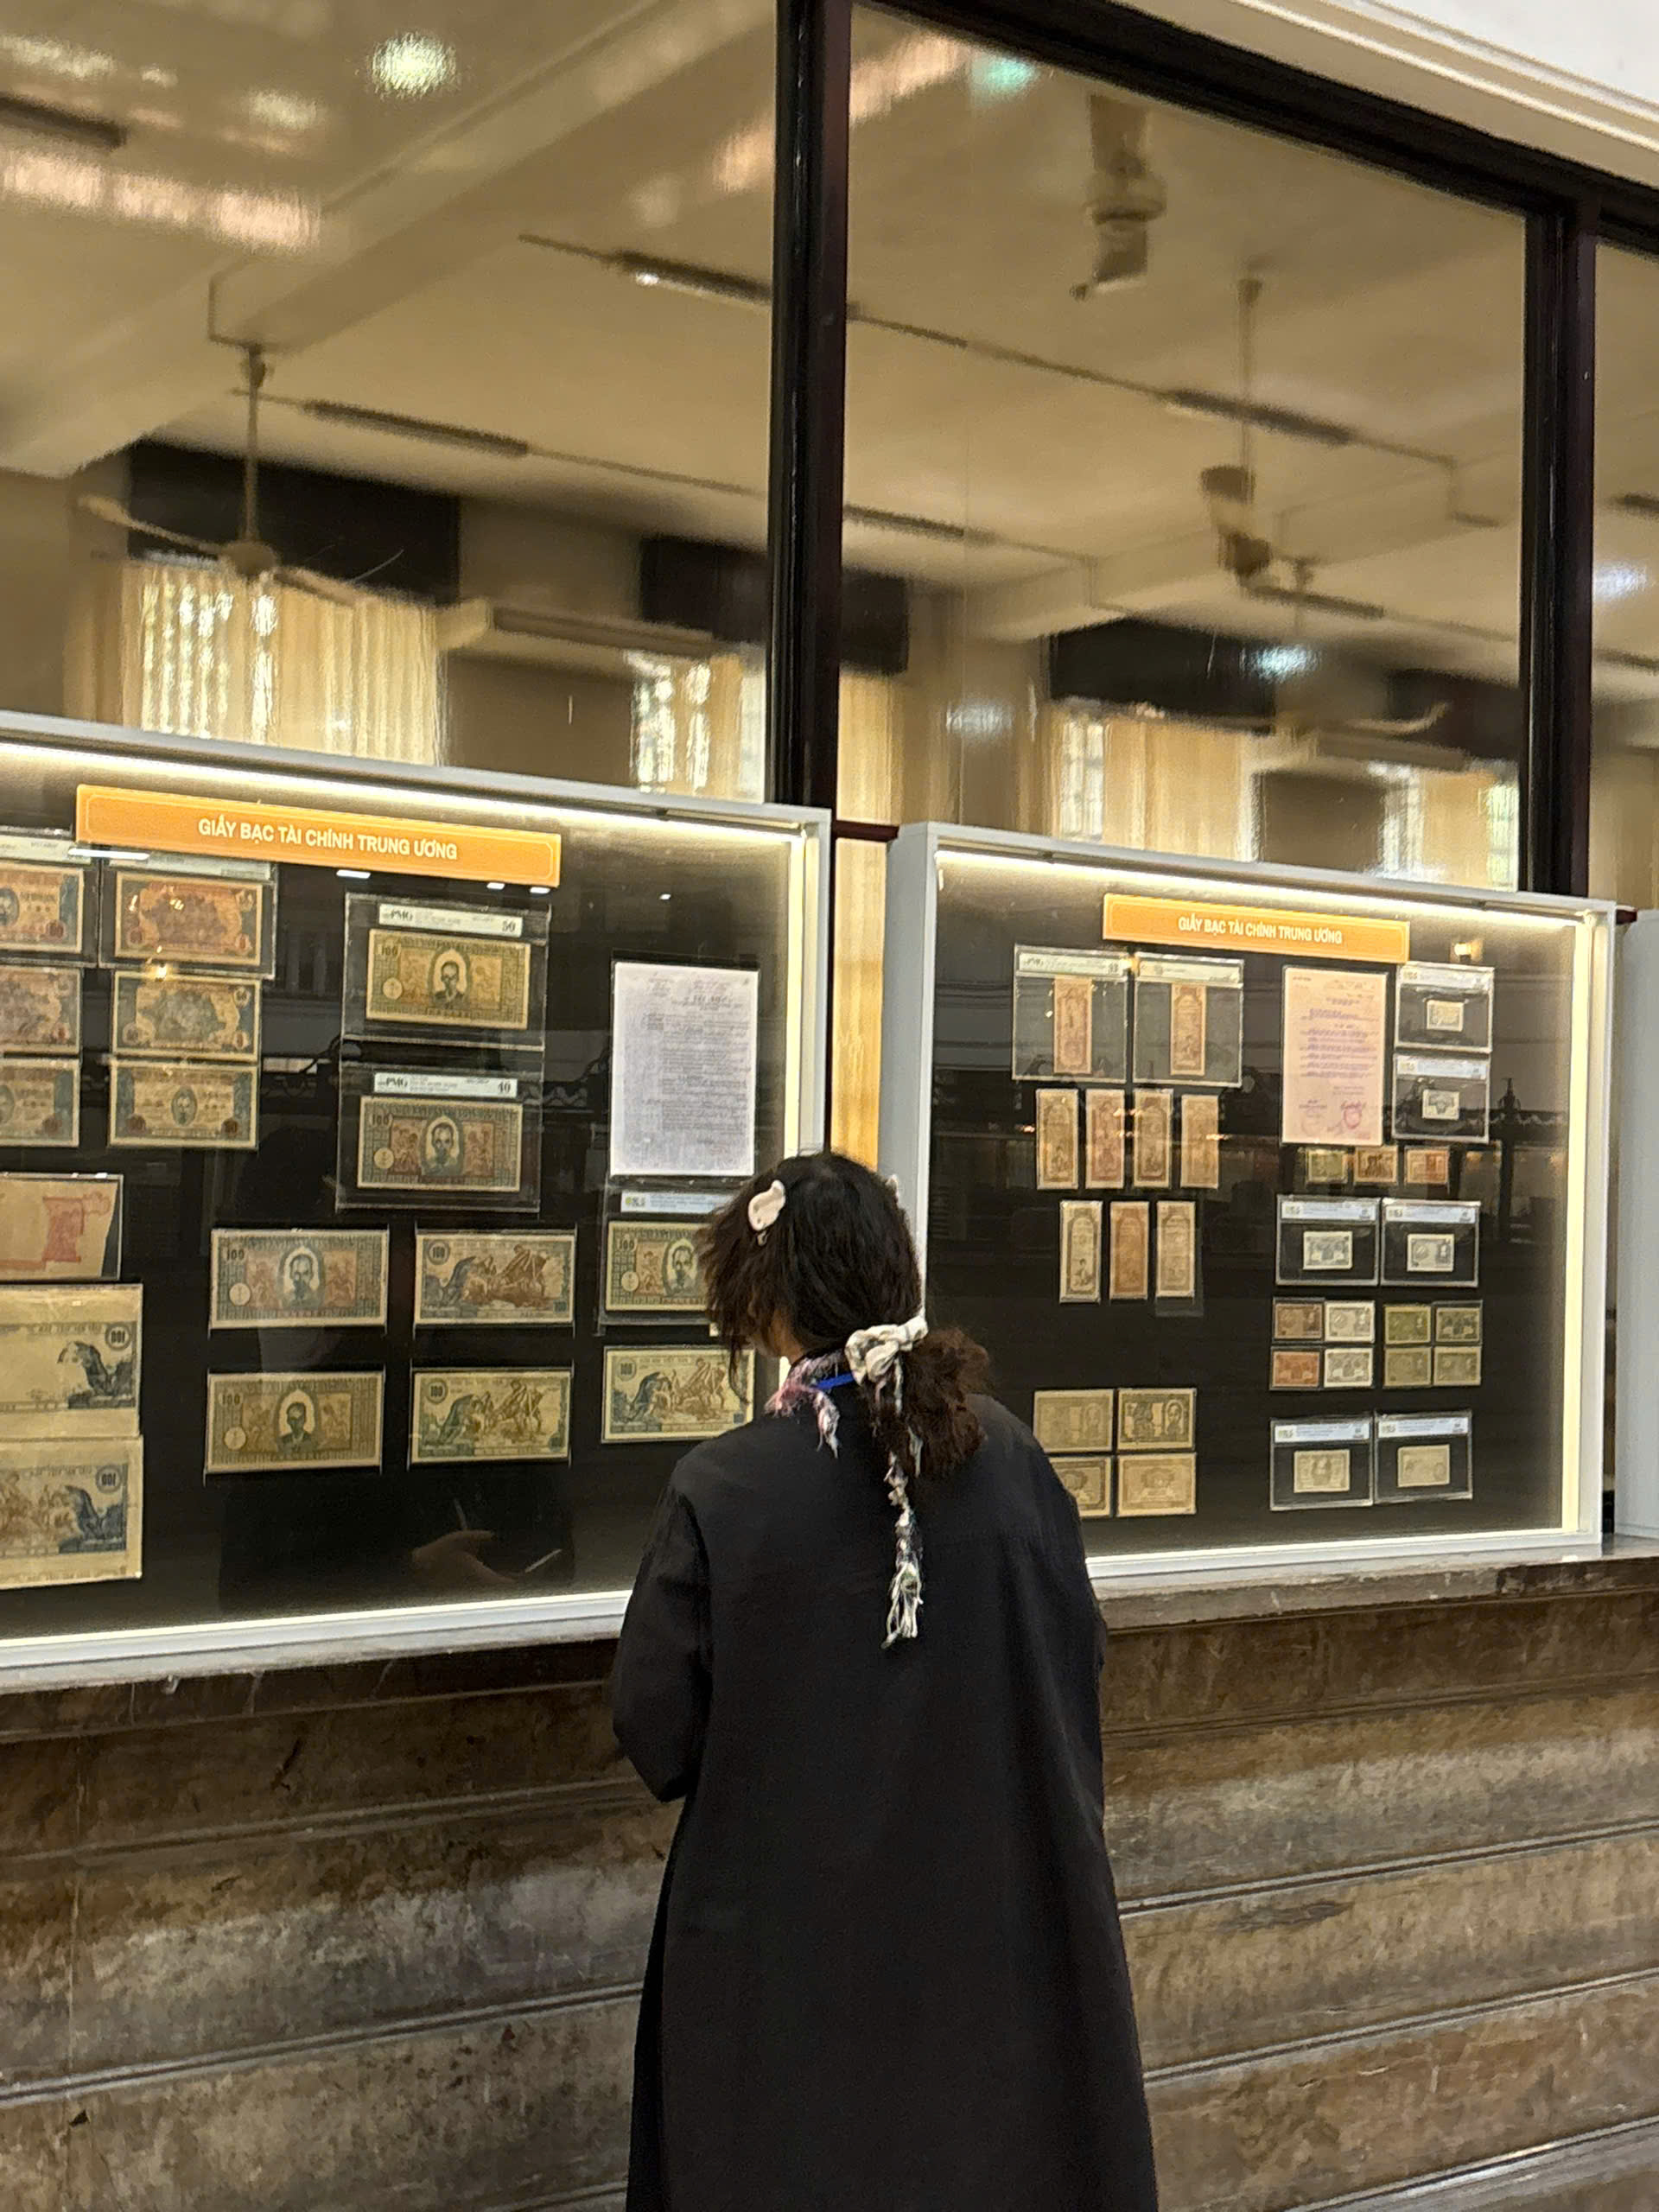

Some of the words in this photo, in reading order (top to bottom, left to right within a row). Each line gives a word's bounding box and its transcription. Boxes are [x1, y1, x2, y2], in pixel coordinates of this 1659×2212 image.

[198, 814, 236, 837] GIẤY
[240, 822, 274, 843] BẠC
[277, 824, 302, 843] TÀI
[305, 828, 353, 849] CHÍNH
[357, 834, 410, 855] TRUNG
[414, 838, 457, 860] ƯƠNG
[1204, 918, 1226, 936] BẠC
[1228, 919, 1244, 935] TÀI
[1245, 921, 1276, 938] CHÍNH
[1279, 925, 1313, 941] TRUNG
[1313, 927, 1342, 944] ƯƠNG
[226, 1249, 245, 1261] 100
